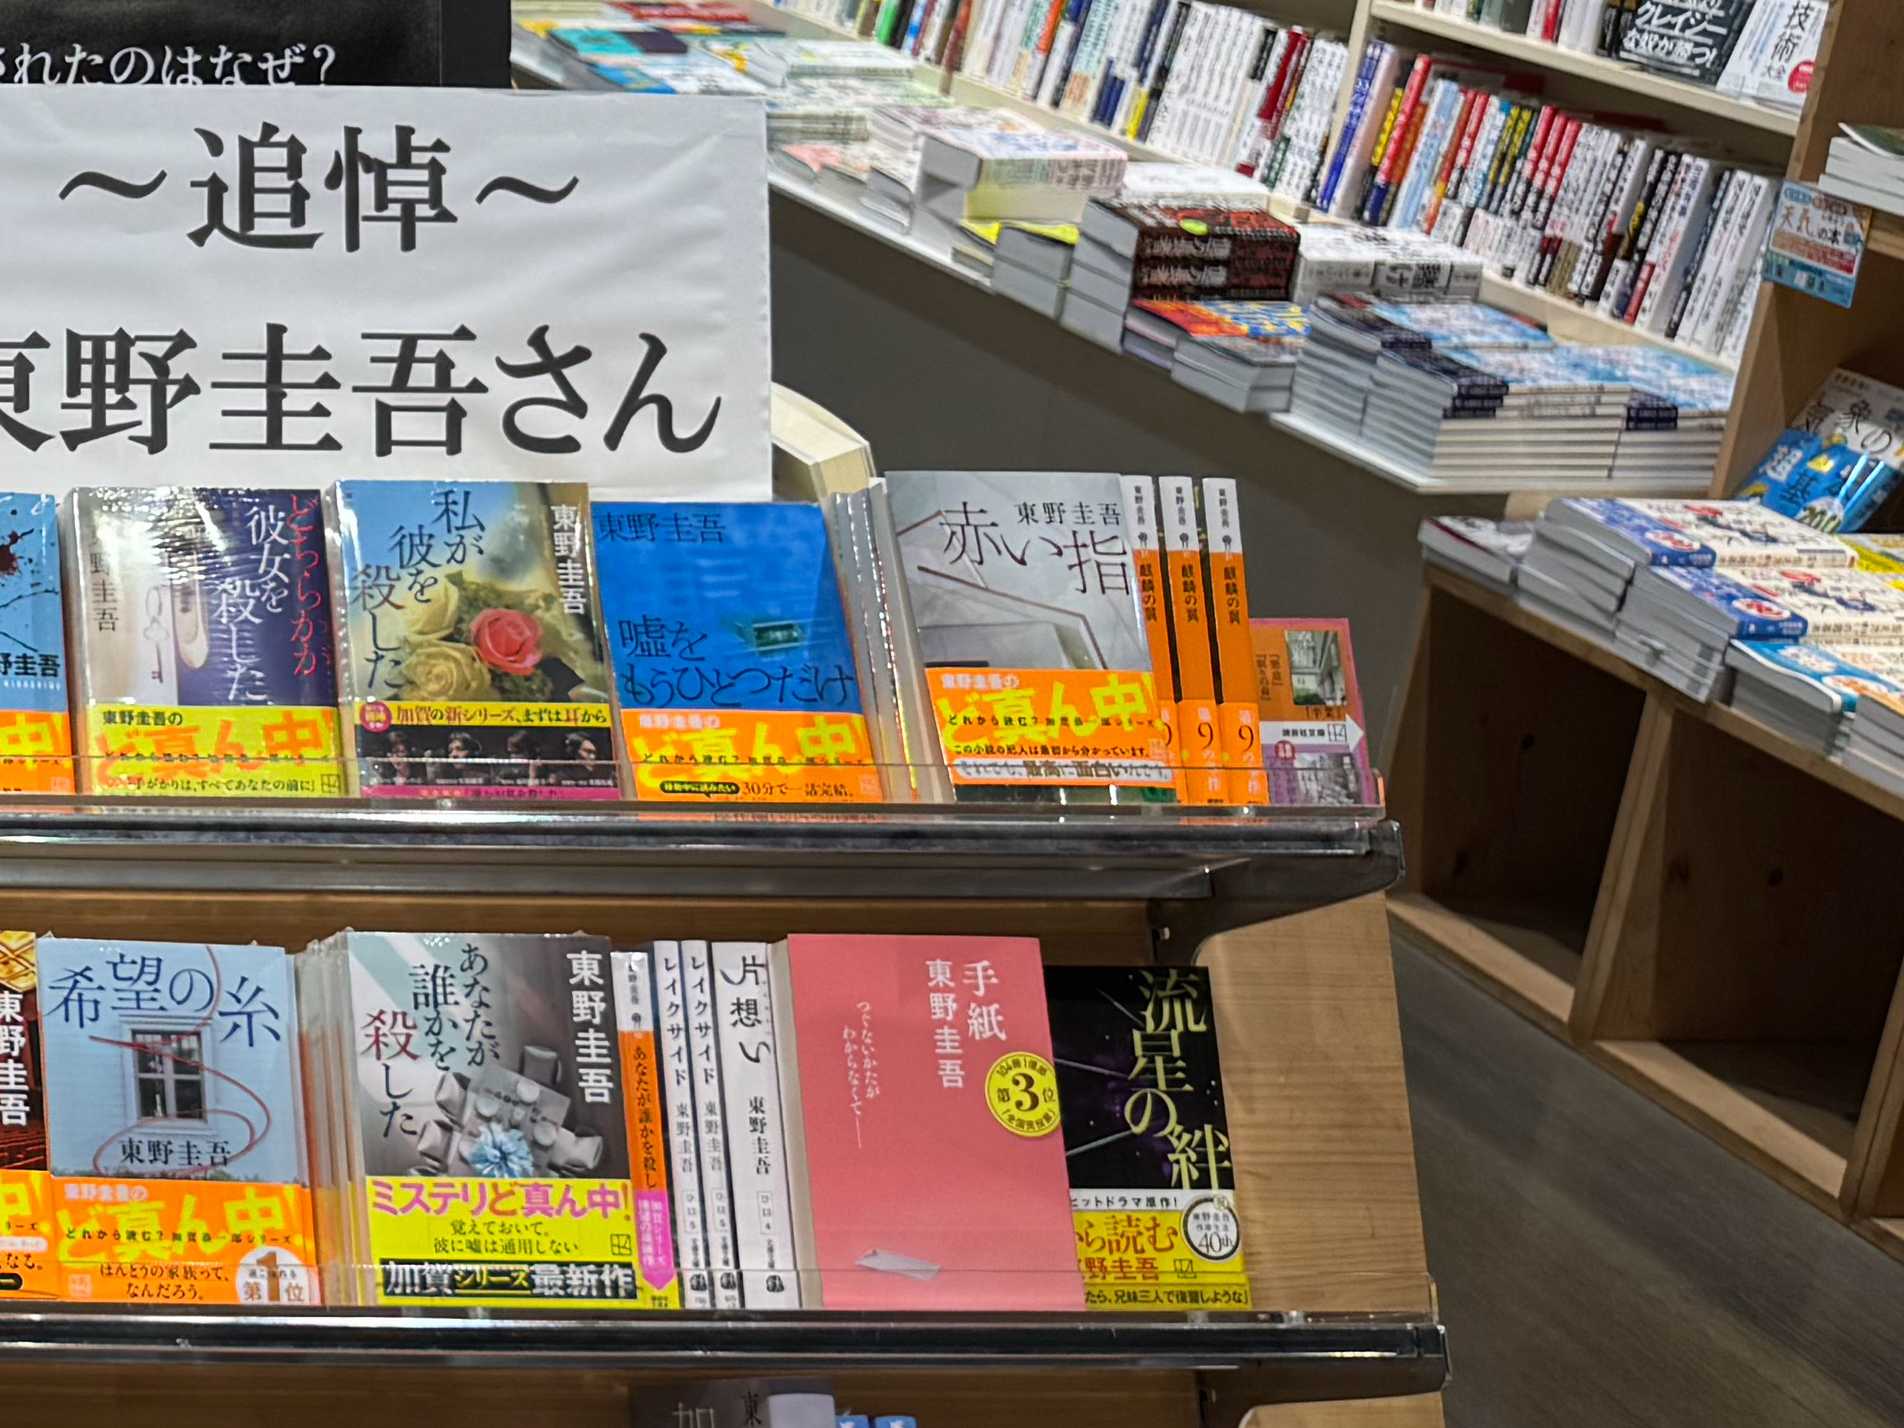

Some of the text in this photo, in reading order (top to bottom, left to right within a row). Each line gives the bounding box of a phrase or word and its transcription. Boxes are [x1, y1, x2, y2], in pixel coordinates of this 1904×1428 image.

[433, 490, 486, 566] 私が
[939, 500, 1131, 598] 赤い指
[619, 613, 709, 663] 嘘を
[621, 661, 856, 710] もうひとつだけ
[47, 952, 284, 1049] 希望の糸
[412, 963, 458, 1072] 誰かを
[460, 943, 501, 1068] あなたが
[722, 955, 772, 1064] 片想い
[962, 959, 1008, 1043] 手紙
[1124, 967, 1208, 1138] 流星の
[1165, 1123, 1231, 1192] 絆
[370, 1175, 633, 1221] ミステリど真ん中!
[384, 1261, 639, 1299] 加賀シリーズ最新作
[433, 1236, 580, 1256] 彼に嘘は通用しない
